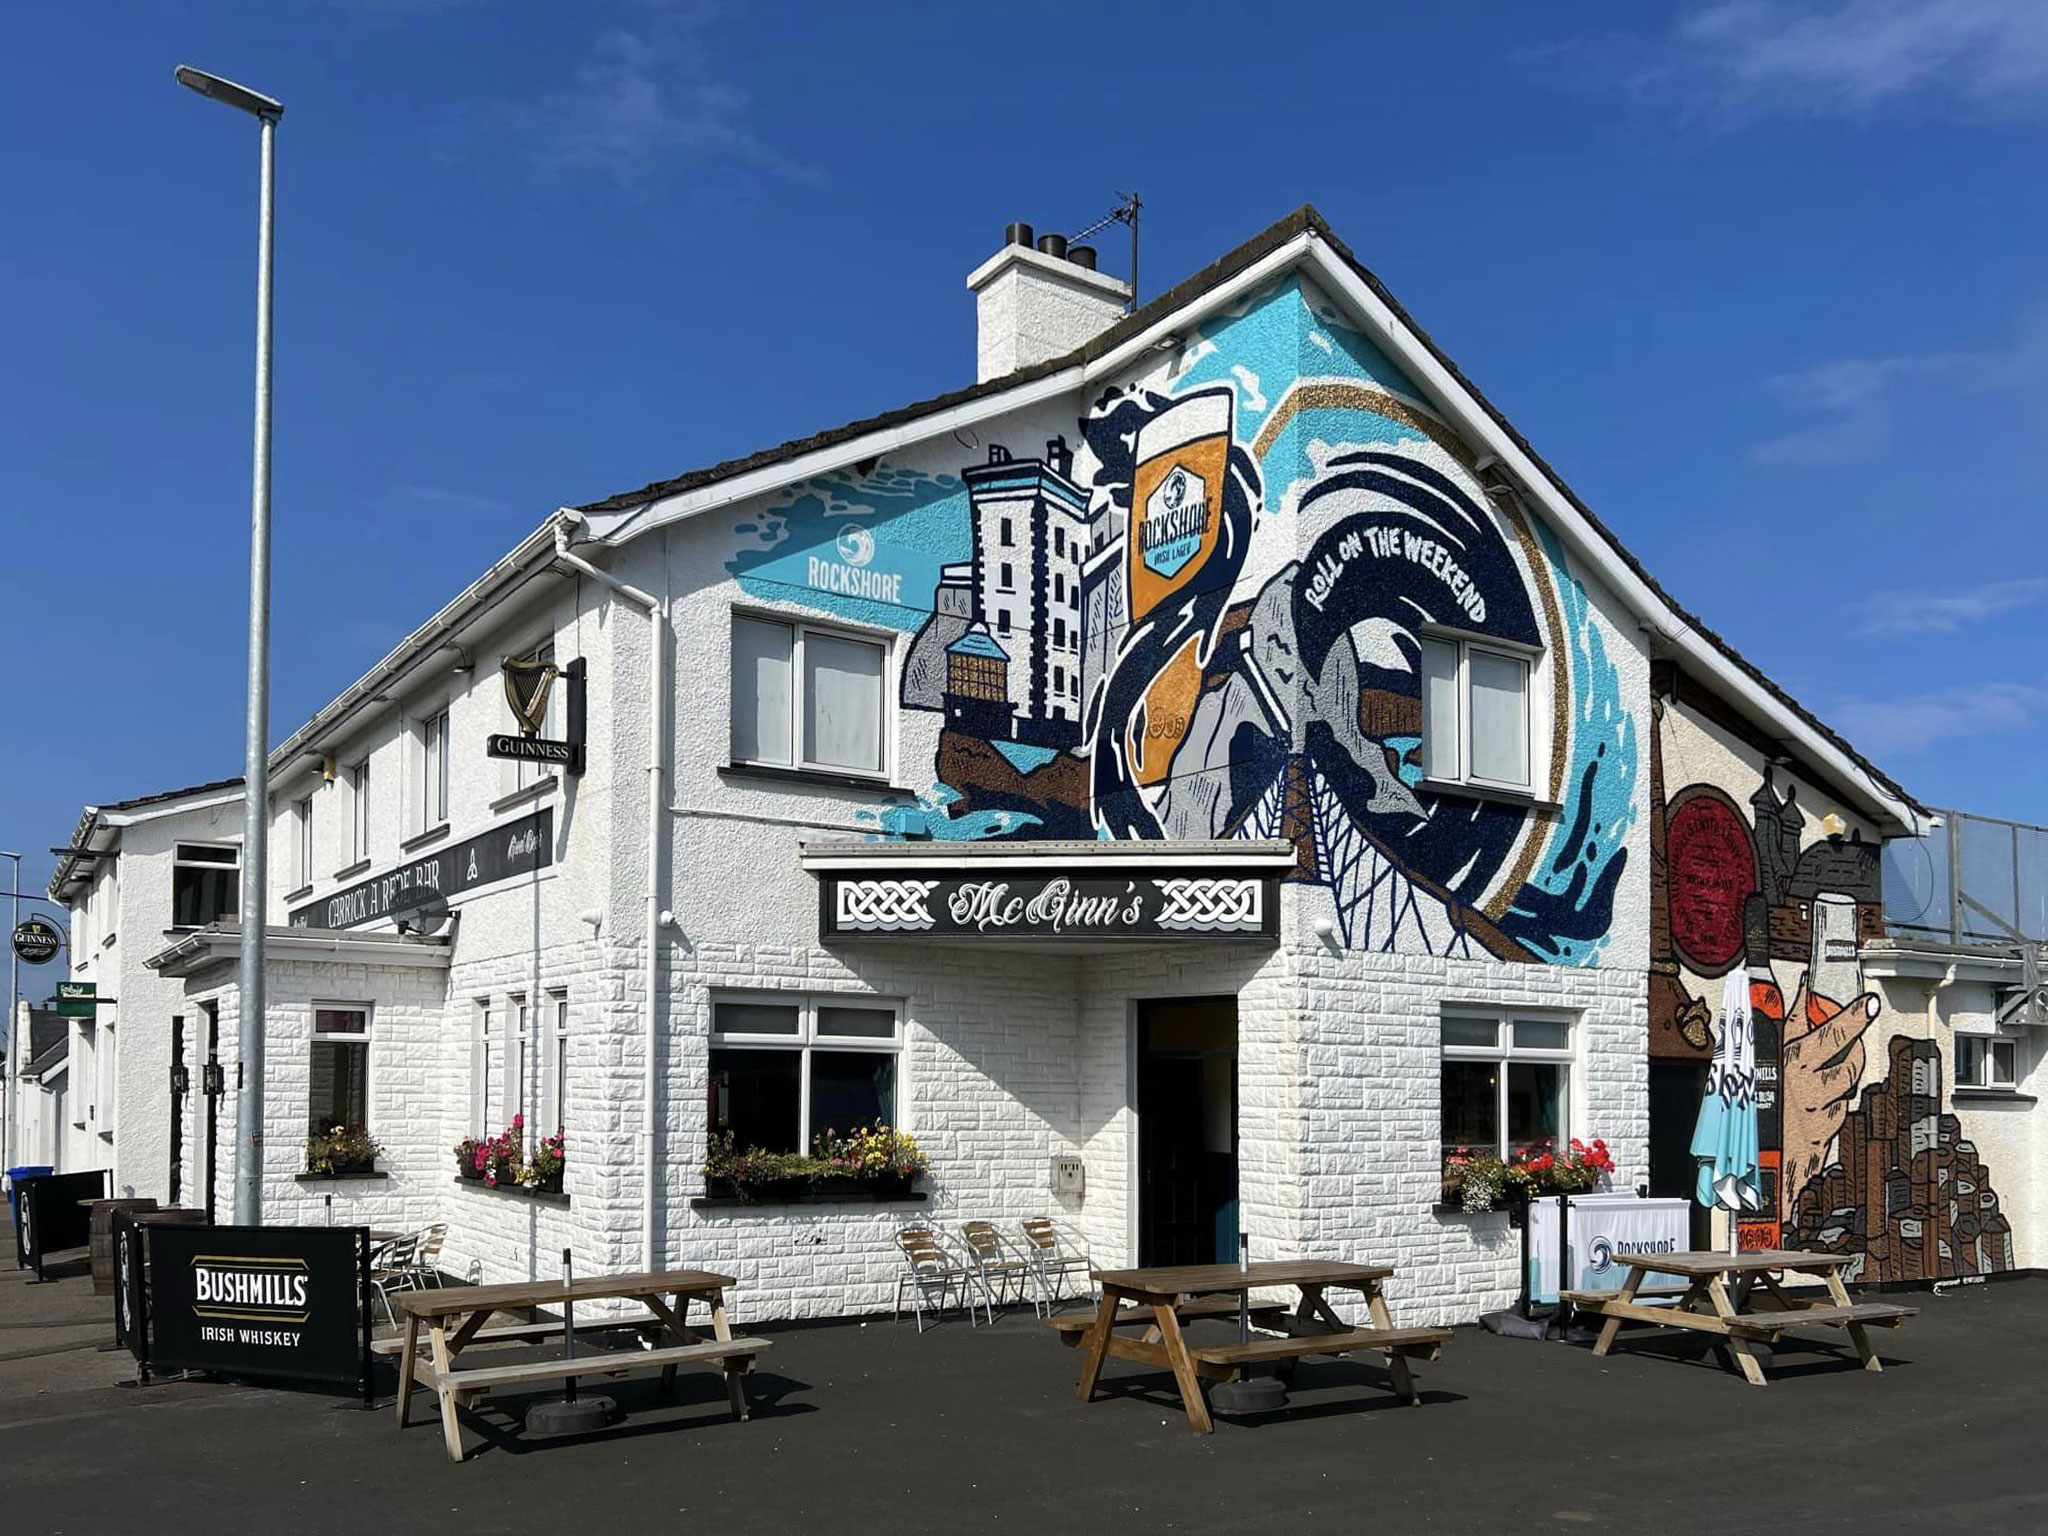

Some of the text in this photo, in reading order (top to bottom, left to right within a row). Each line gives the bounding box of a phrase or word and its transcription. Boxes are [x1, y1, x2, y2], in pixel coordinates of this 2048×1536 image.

[1138, 496, 1212, 556] ROCKSHORE
[808, 555, 902, 604] ROCKSHORE
[1305, 526, 1486, 623] ROLL ON THE WEEKEND
[497, 737, 569, 759] GUINNESS
[328, 887, 367, 929] CARRICK
[370, 882, 378, 915] A
[416, 859, 440, 895] BAR
[948, 876, 1144, 934] McGinn's
[14, 932, 57, 945] GUINNESS
[196, 1267, 308, 1307] BUSHMILLS
[201, 1326, 301, 1347] IRISH WHISKEY
